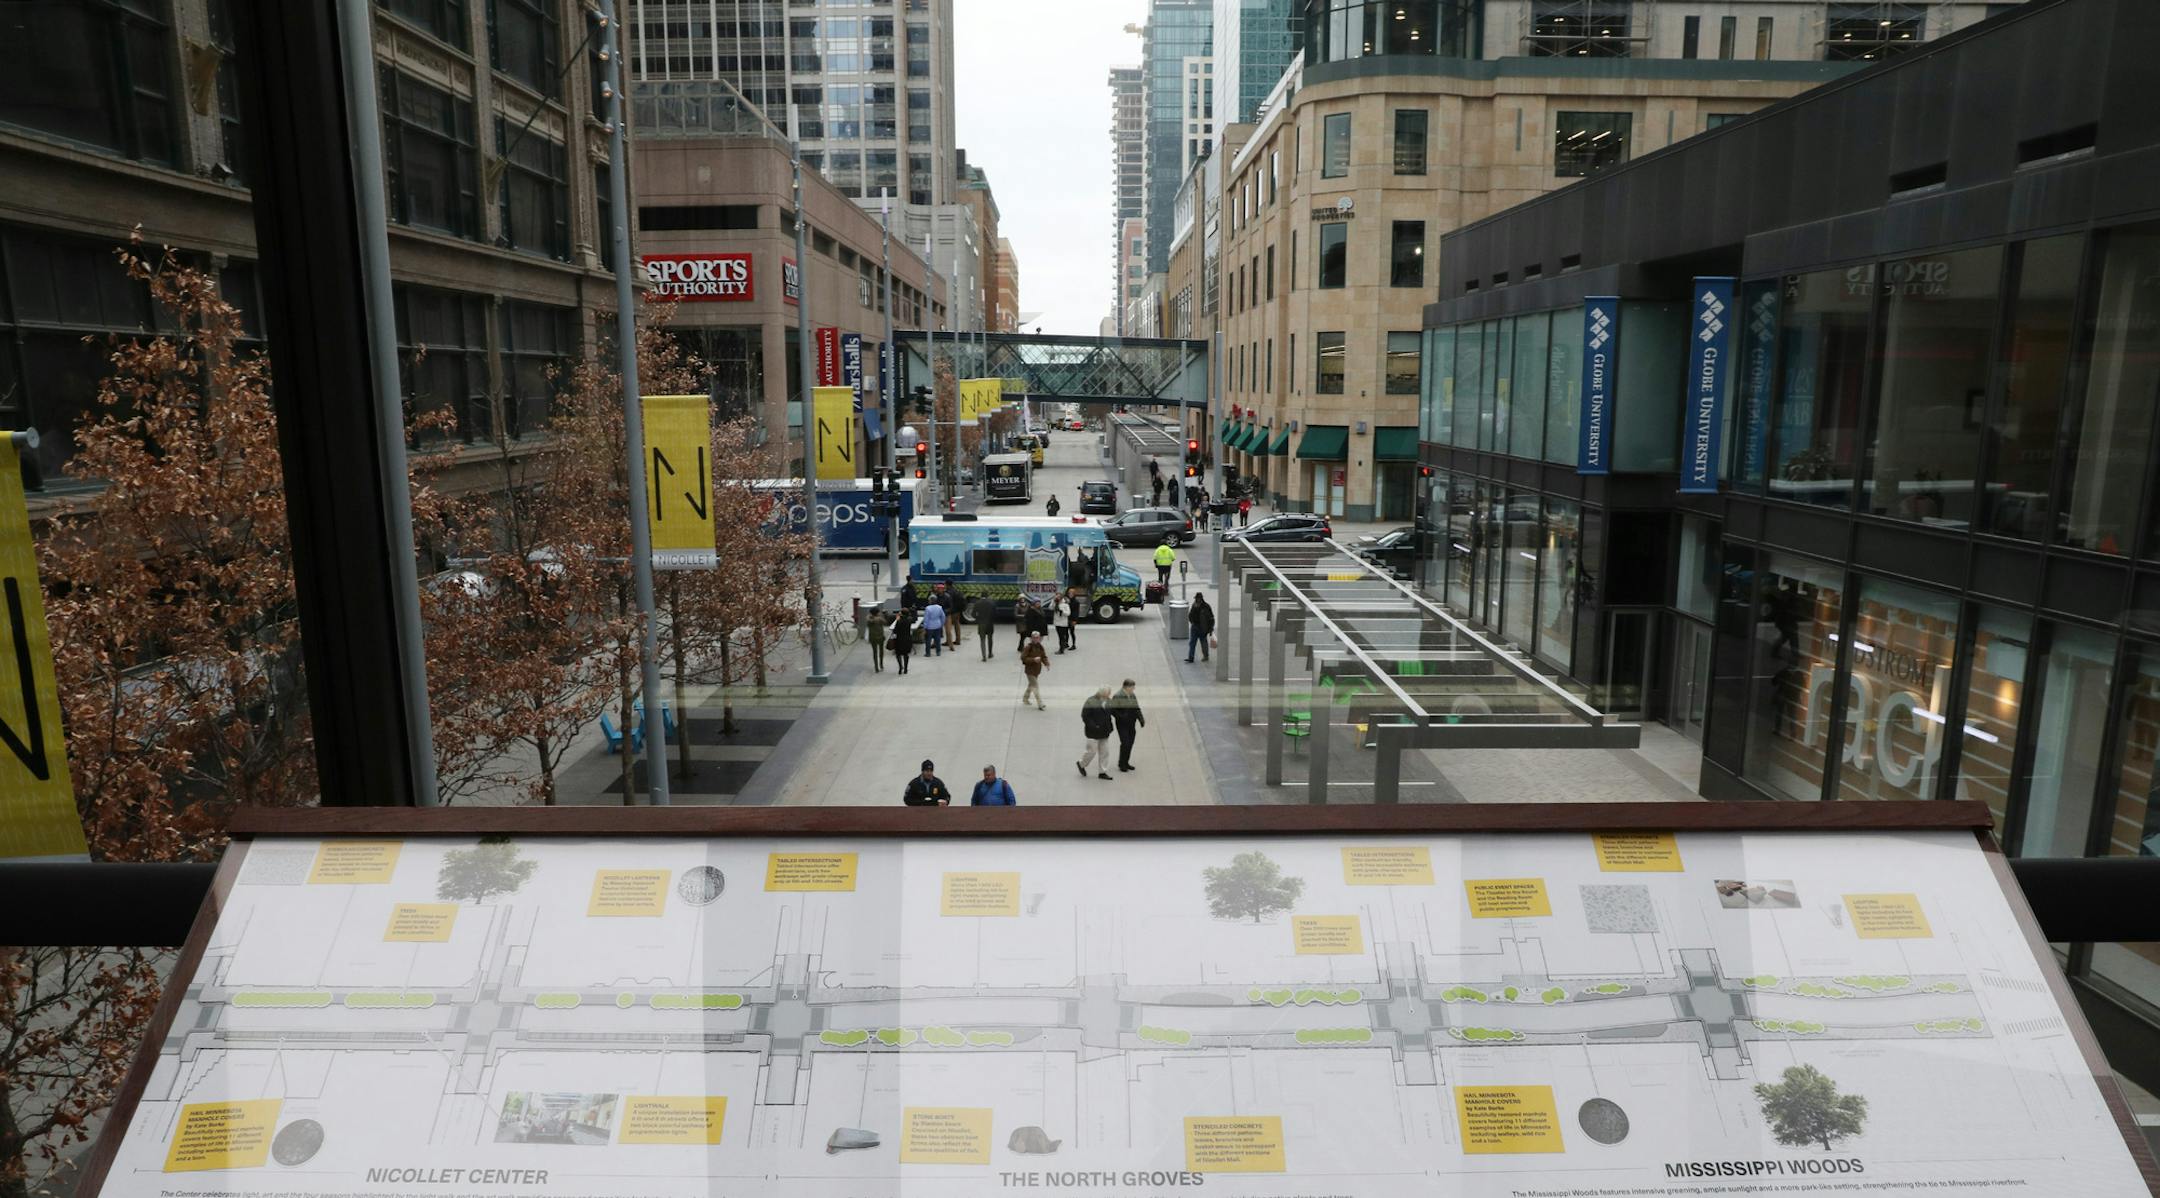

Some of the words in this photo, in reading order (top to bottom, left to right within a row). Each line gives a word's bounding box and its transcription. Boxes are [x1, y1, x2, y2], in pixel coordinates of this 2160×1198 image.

[647, 260, 748, 282] SPORTS
[651, 281, 748, 295] AUTHORITY
[824, 329, 833, 383] AUTHORITY
[845, 337, 861, 410] Marshalls
[1593, 353, 1606, 391] GLOBE
[1702, 347, 1718, 392] GLOBE
[1588, 394, 1604, 466] UNIVERSITY
[1694, 396, 1714, 484] UNIVERSITY
[992, 476, 1020, 484] MEYER
[659, 553, 711, 566] NICOLLET
[366, 1168, 465, 1183] NICOLLET
[468, 1169, 548, 1184] CENTER
[1665, 1160, 1784, 1177] MISSISSIPPI
[1787, 1158, 1864, 1174] WOODS
[999, 1172, 1039, 1187] THE
[1046, 1172, 1116, 1187] NORTH
[1122, 1171, 1204, 1187] GROVES
[1528, 1190, 1570, 1198] Mississippi
[1666, 1187, 1702, 1195] greening,
[1728, 1185, 1757, 1193] sunlight
[1801, 1184, 1833, 1192] park-like
[1862, 1181, 1915, 1190] strengthening
[1948, 1179, 1990, 1188] Mississippi
[160, 1190, 174, 1198] The
[175, 1190, 201, 1198] Center
